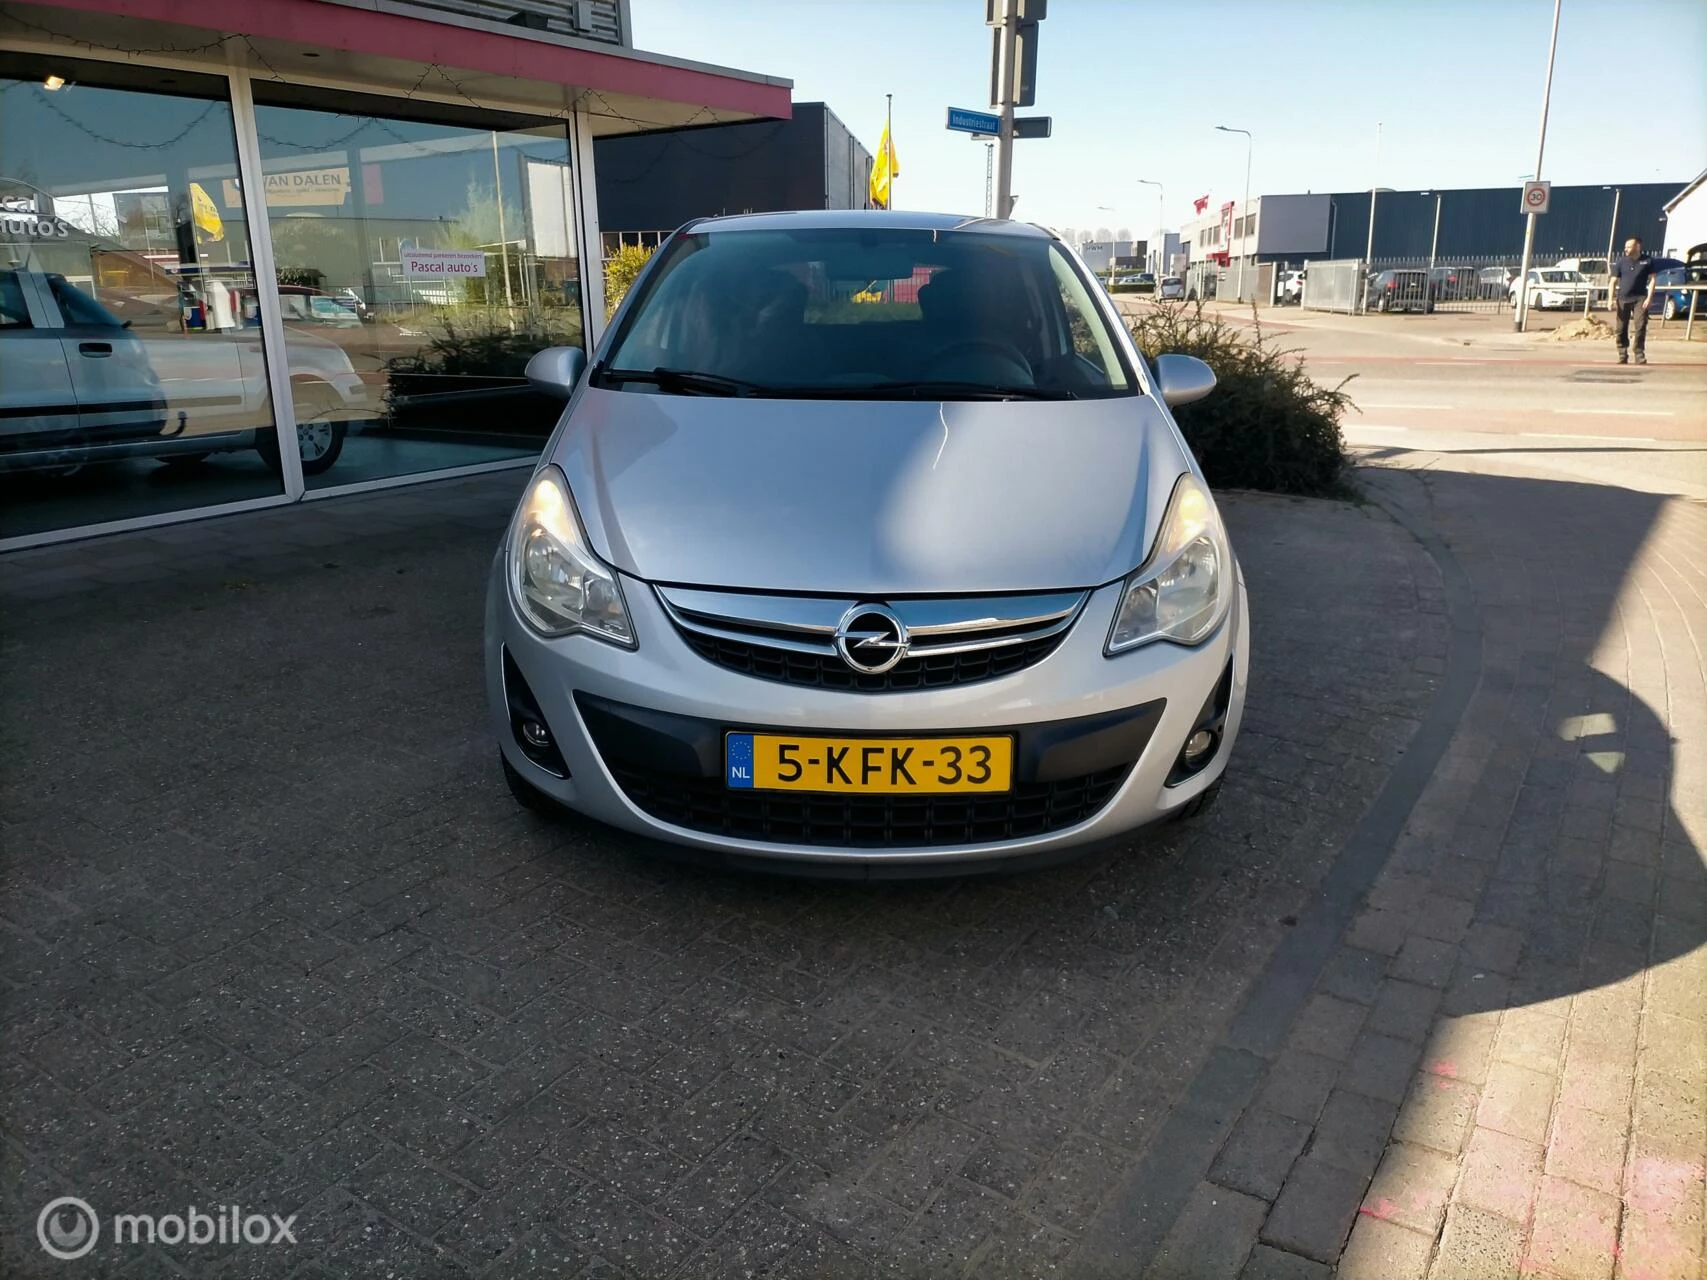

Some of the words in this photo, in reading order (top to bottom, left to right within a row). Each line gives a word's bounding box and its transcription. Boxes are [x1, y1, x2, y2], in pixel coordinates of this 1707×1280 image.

[952, 114, 996, 130] Industriestraat
[293, 174, 341, 186] DALEN
[1, 193, 39, 213] cal
[1530, 193, 1542, 201] 30
[411, 261, 445, 272] Pascal
[447, 263, 478, 272] auto's
[732, 767, 750, 779] NL
[777, 744, 992, 785] 5-KFK-33
